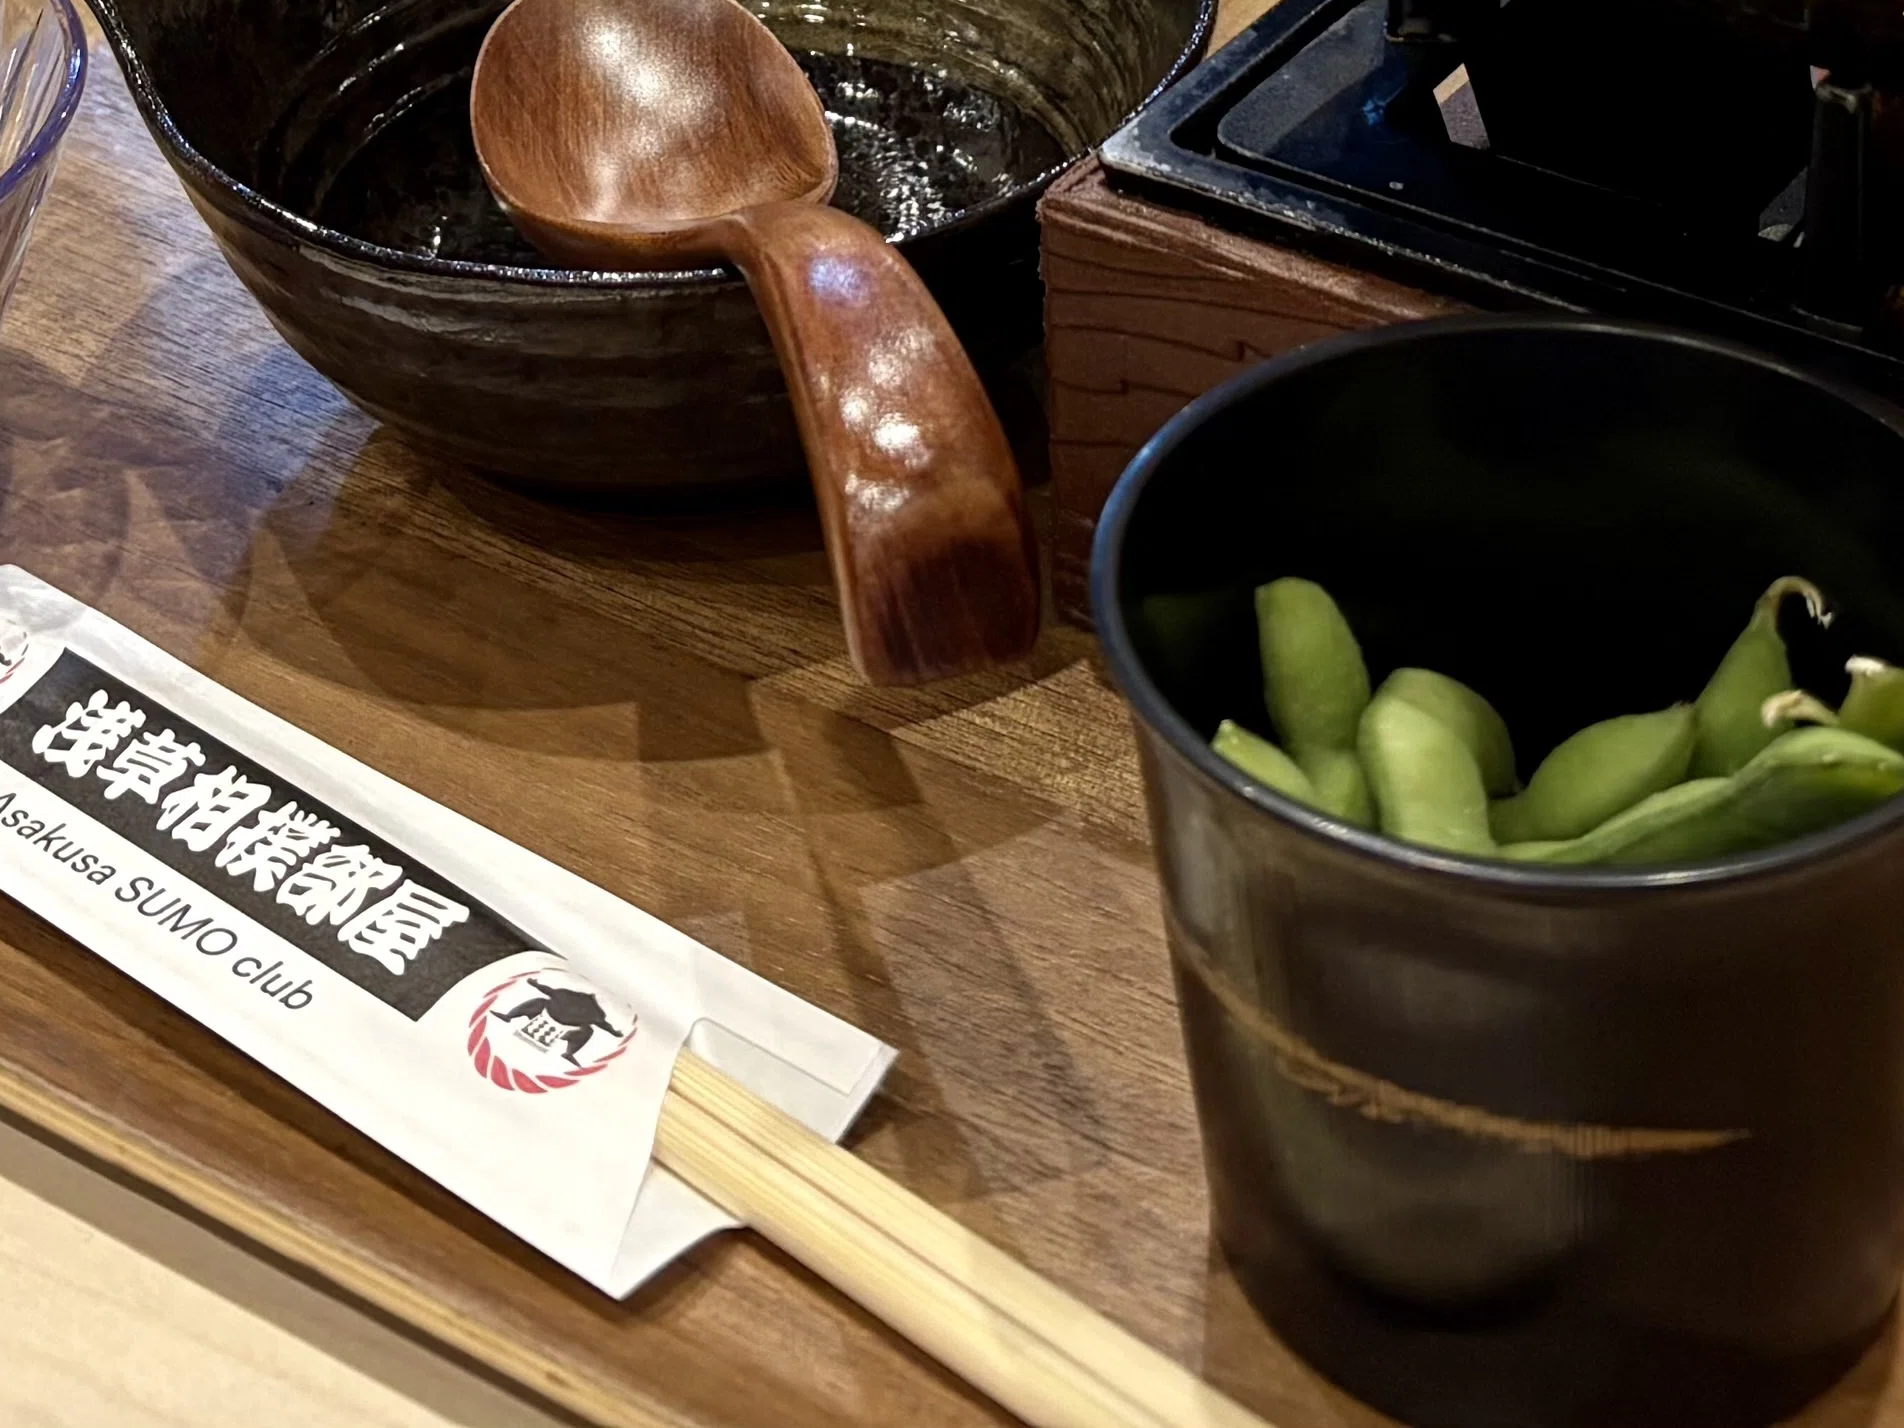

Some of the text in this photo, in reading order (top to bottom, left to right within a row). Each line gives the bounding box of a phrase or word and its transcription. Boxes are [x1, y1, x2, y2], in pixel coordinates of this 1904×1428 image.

[31, 689, 470, 976] 浅草相撲部屋
[114, 876, 238, 956] SUMO
[231, 954, 313, 1011] club
